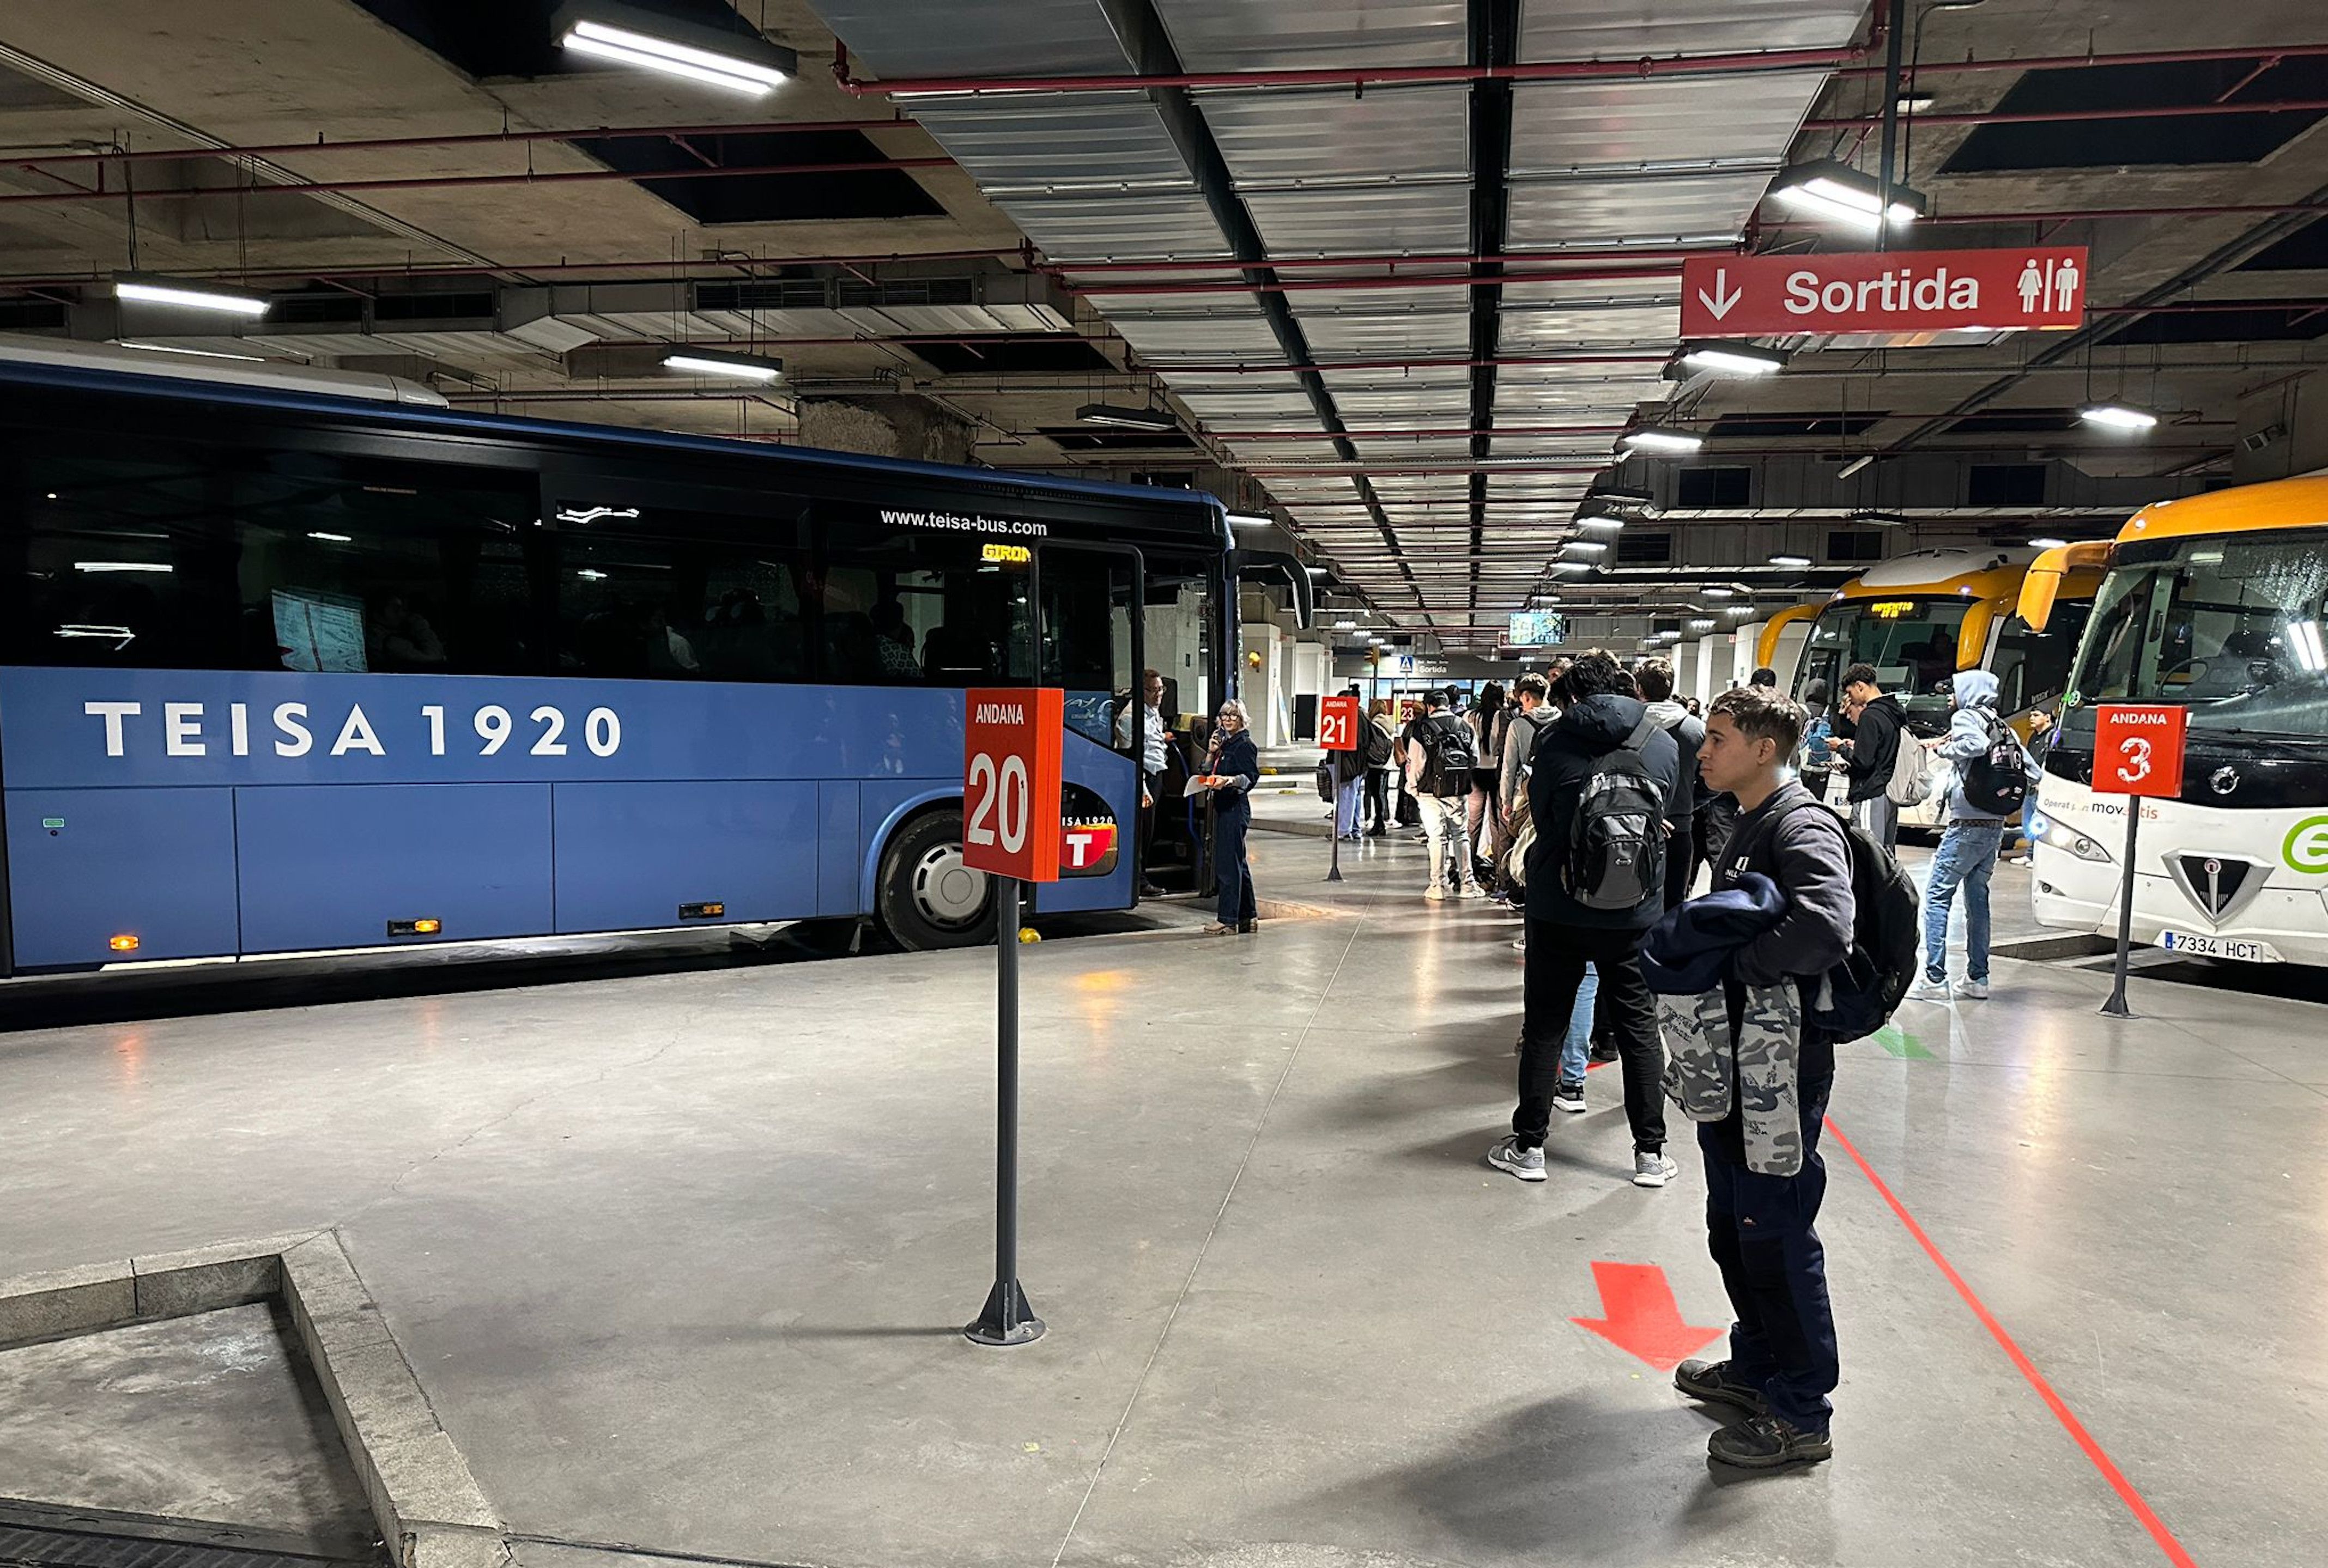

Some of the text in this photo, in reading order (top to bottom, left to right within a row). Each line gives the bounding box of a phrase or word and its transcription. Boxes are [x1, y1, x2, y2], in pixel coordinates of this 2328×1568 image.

[1784, 268, 1979, 314] Sortida
[881, 509, 1047, 536] www.teisa-bus.com
[1420, 665, 1447, 673] Sortida
[975, 704, 1024, 725] ANDANA
[1401, 707, 1414, 720] 23
[2110, 712, 2167, 725] ANDANA
[84, 702, 621, 757] TEISA 1920
[1322, 714, 1346, 743] 21
[2117, 737, 2151, 782] 3
[967, 752, 1028, 853] 20
[2044, 798, 2069, 809] Operat
[1086, 816, 1113, 825] 1920
[1066, 834, 1092, 866] T
[2178, 935, 2216, 953] 7334
[2226, 942, 2257, 959] HCT
